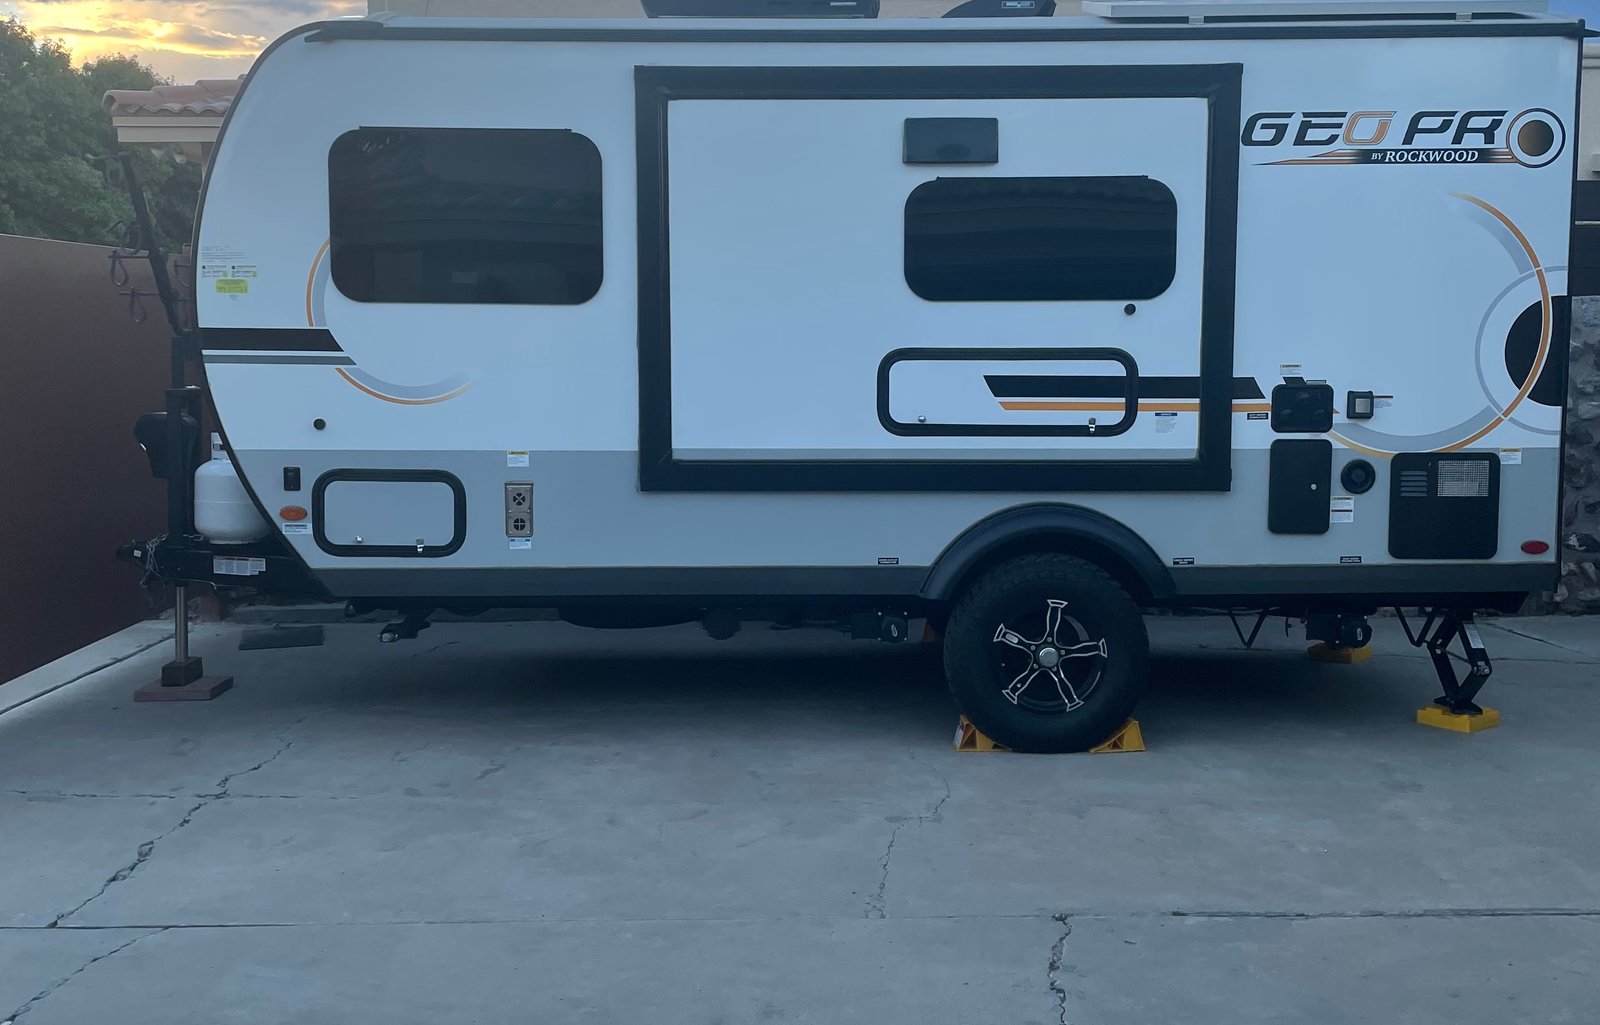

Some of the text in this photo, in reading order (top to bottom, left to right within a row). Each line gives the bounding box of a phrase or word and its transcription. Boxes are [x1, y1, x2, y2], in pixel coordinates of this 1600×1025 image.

[1241, 111, 1397, 146] GEO
[1371, 150, 1479, 163] BY ROCKWOOD
